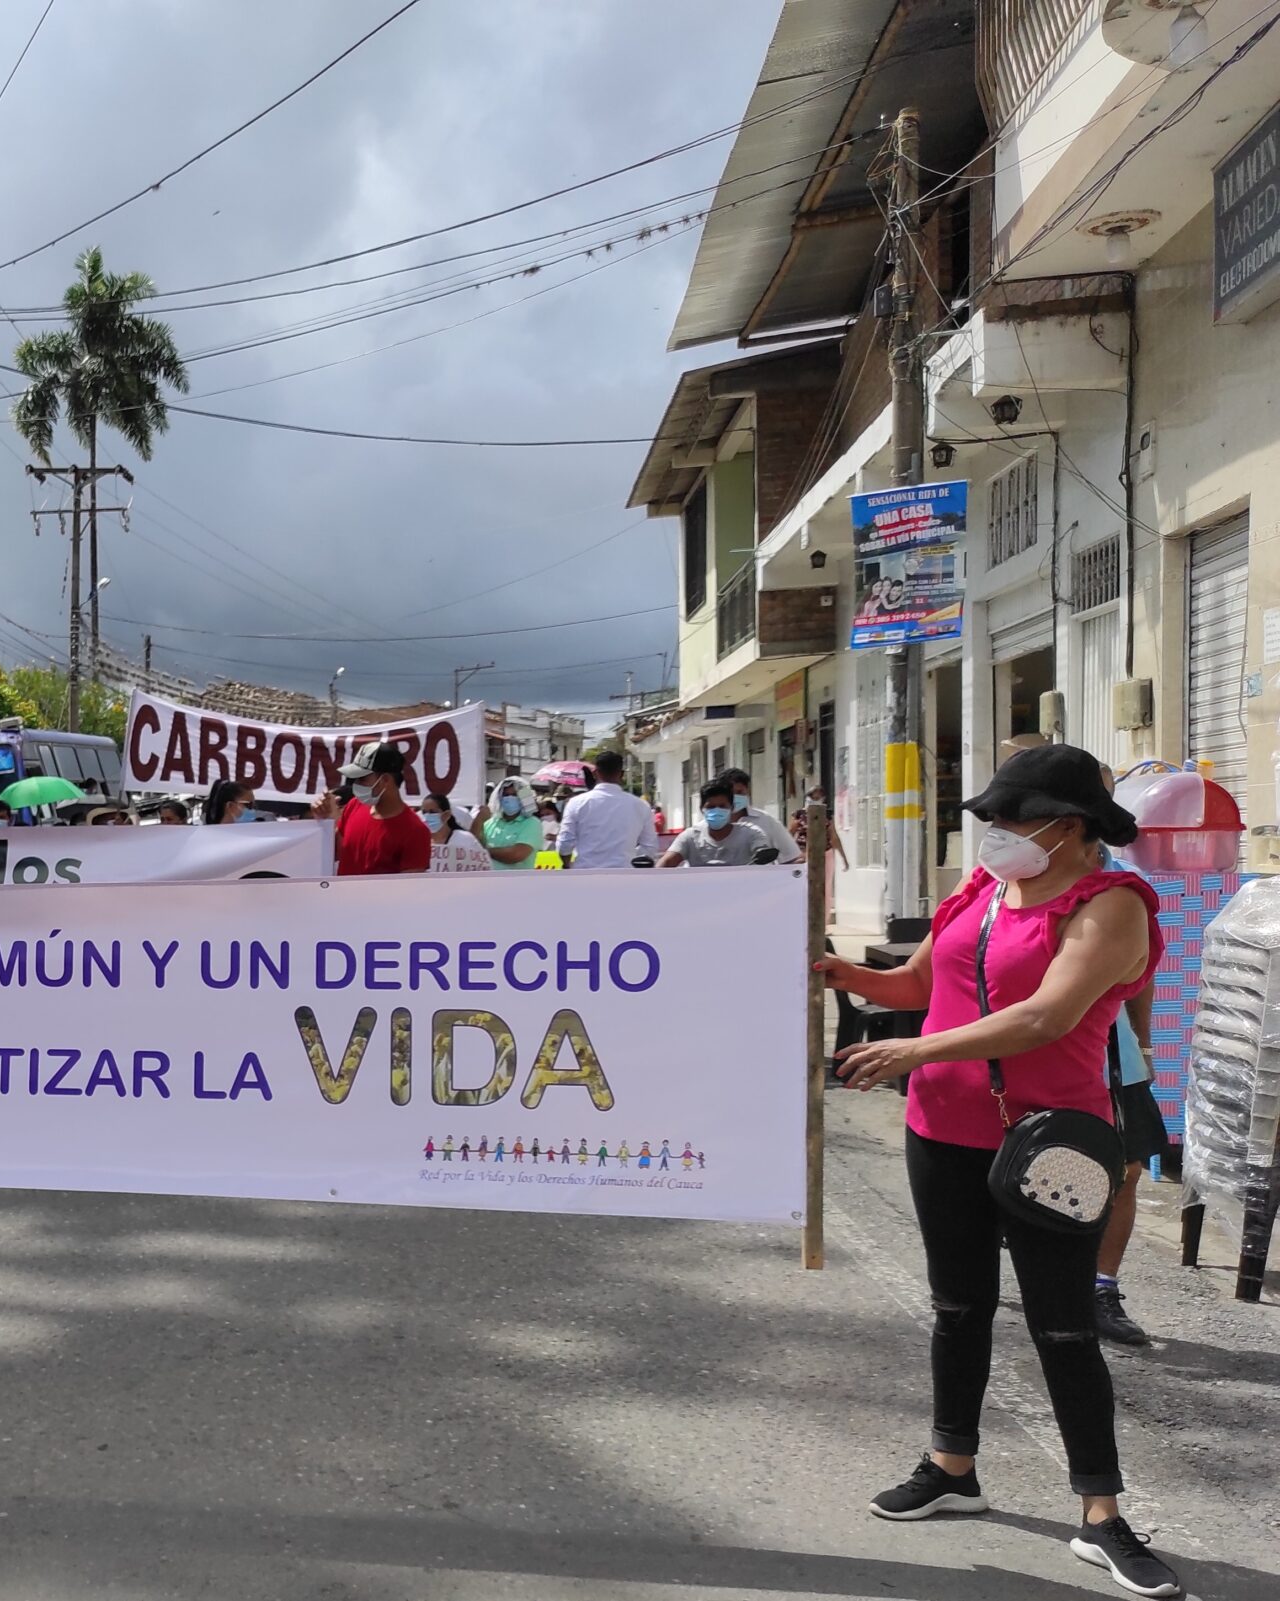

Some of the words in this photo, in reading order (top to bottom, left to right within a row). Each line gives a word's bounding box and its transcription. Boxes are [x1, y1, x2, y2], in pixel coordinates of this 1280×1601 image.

[1220, 129, 1278, 216] ALMACEN
[1220, 183, 1280, 258] VARIED
[867, 491, 916, 508] SENSACIONAL
[918, 489, 936, 500] RIFA
[938, 487, 950, 497] DE
[874, 510, 900, 527] UNA
[901, 503, 934, 521] CASA
[859, 538, 885, 553] SOBRE
[886, 536, 896, 546] LA
[910, 525, 956, 540] PRINCIPAL
[141, 940, 180, 989] Y
[200, 940, 290, 990] UN
[315, 940, 661, 993] DERECHO
[193, 1050, 273, 1102] LA
[294, 1006, 615, 1111] VIDA
[420, 1169, 441, 1180] Red
[442, 1171, 462, 1183] por
[464, 1170, 474, 1181] la
[478, 1170, 505, 1182] Vida
[506, 1175, 516, 1186] y
[518, 1171, 533, 1183] los
[536, 1173, 586, 1186] Derechos
[588, 1174, 643, 1188] Humanos
[646, 1176, 664, 1189] del
[667, 1177, 704, 1190] Cauca
